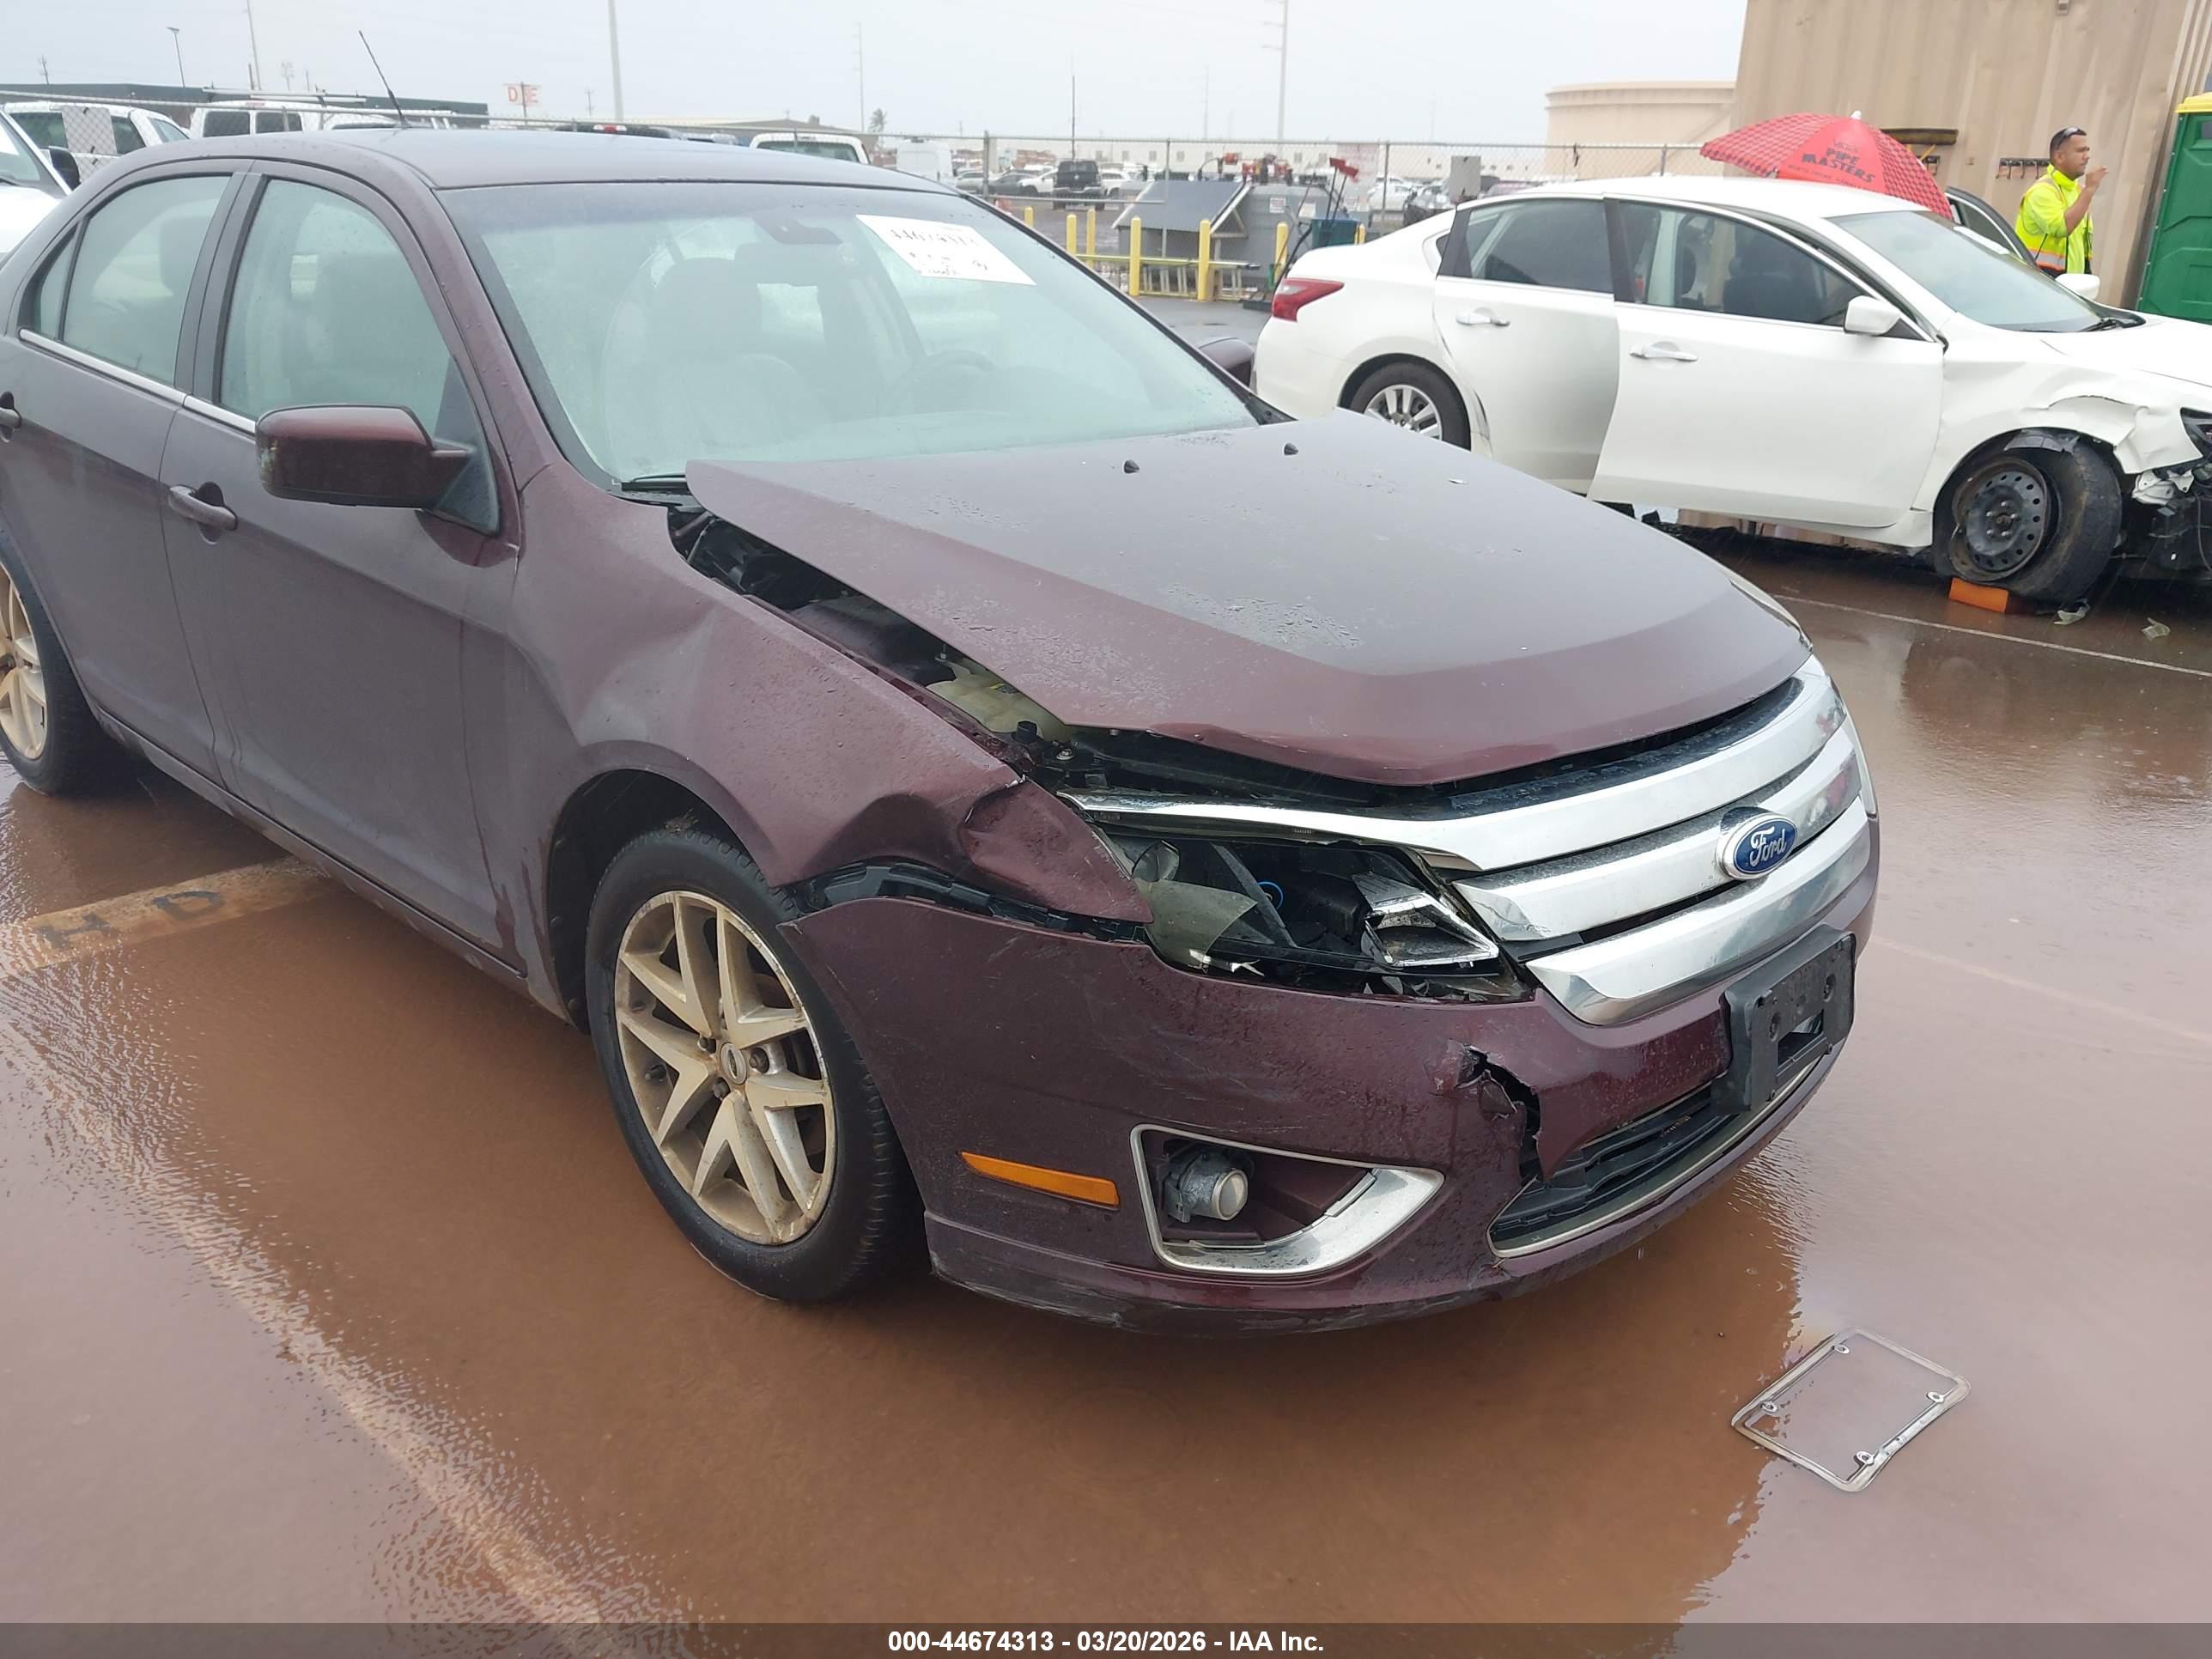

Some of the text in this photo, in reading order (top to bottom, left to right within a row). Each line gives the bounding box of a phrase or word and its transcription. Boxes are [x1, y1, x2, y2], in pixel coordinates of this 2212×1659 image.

[1802, 154, 1876, 183] MASTERS
[1826, 147, 1860, 165] PIPE
[1749, 825, 1787, 867] Ford
